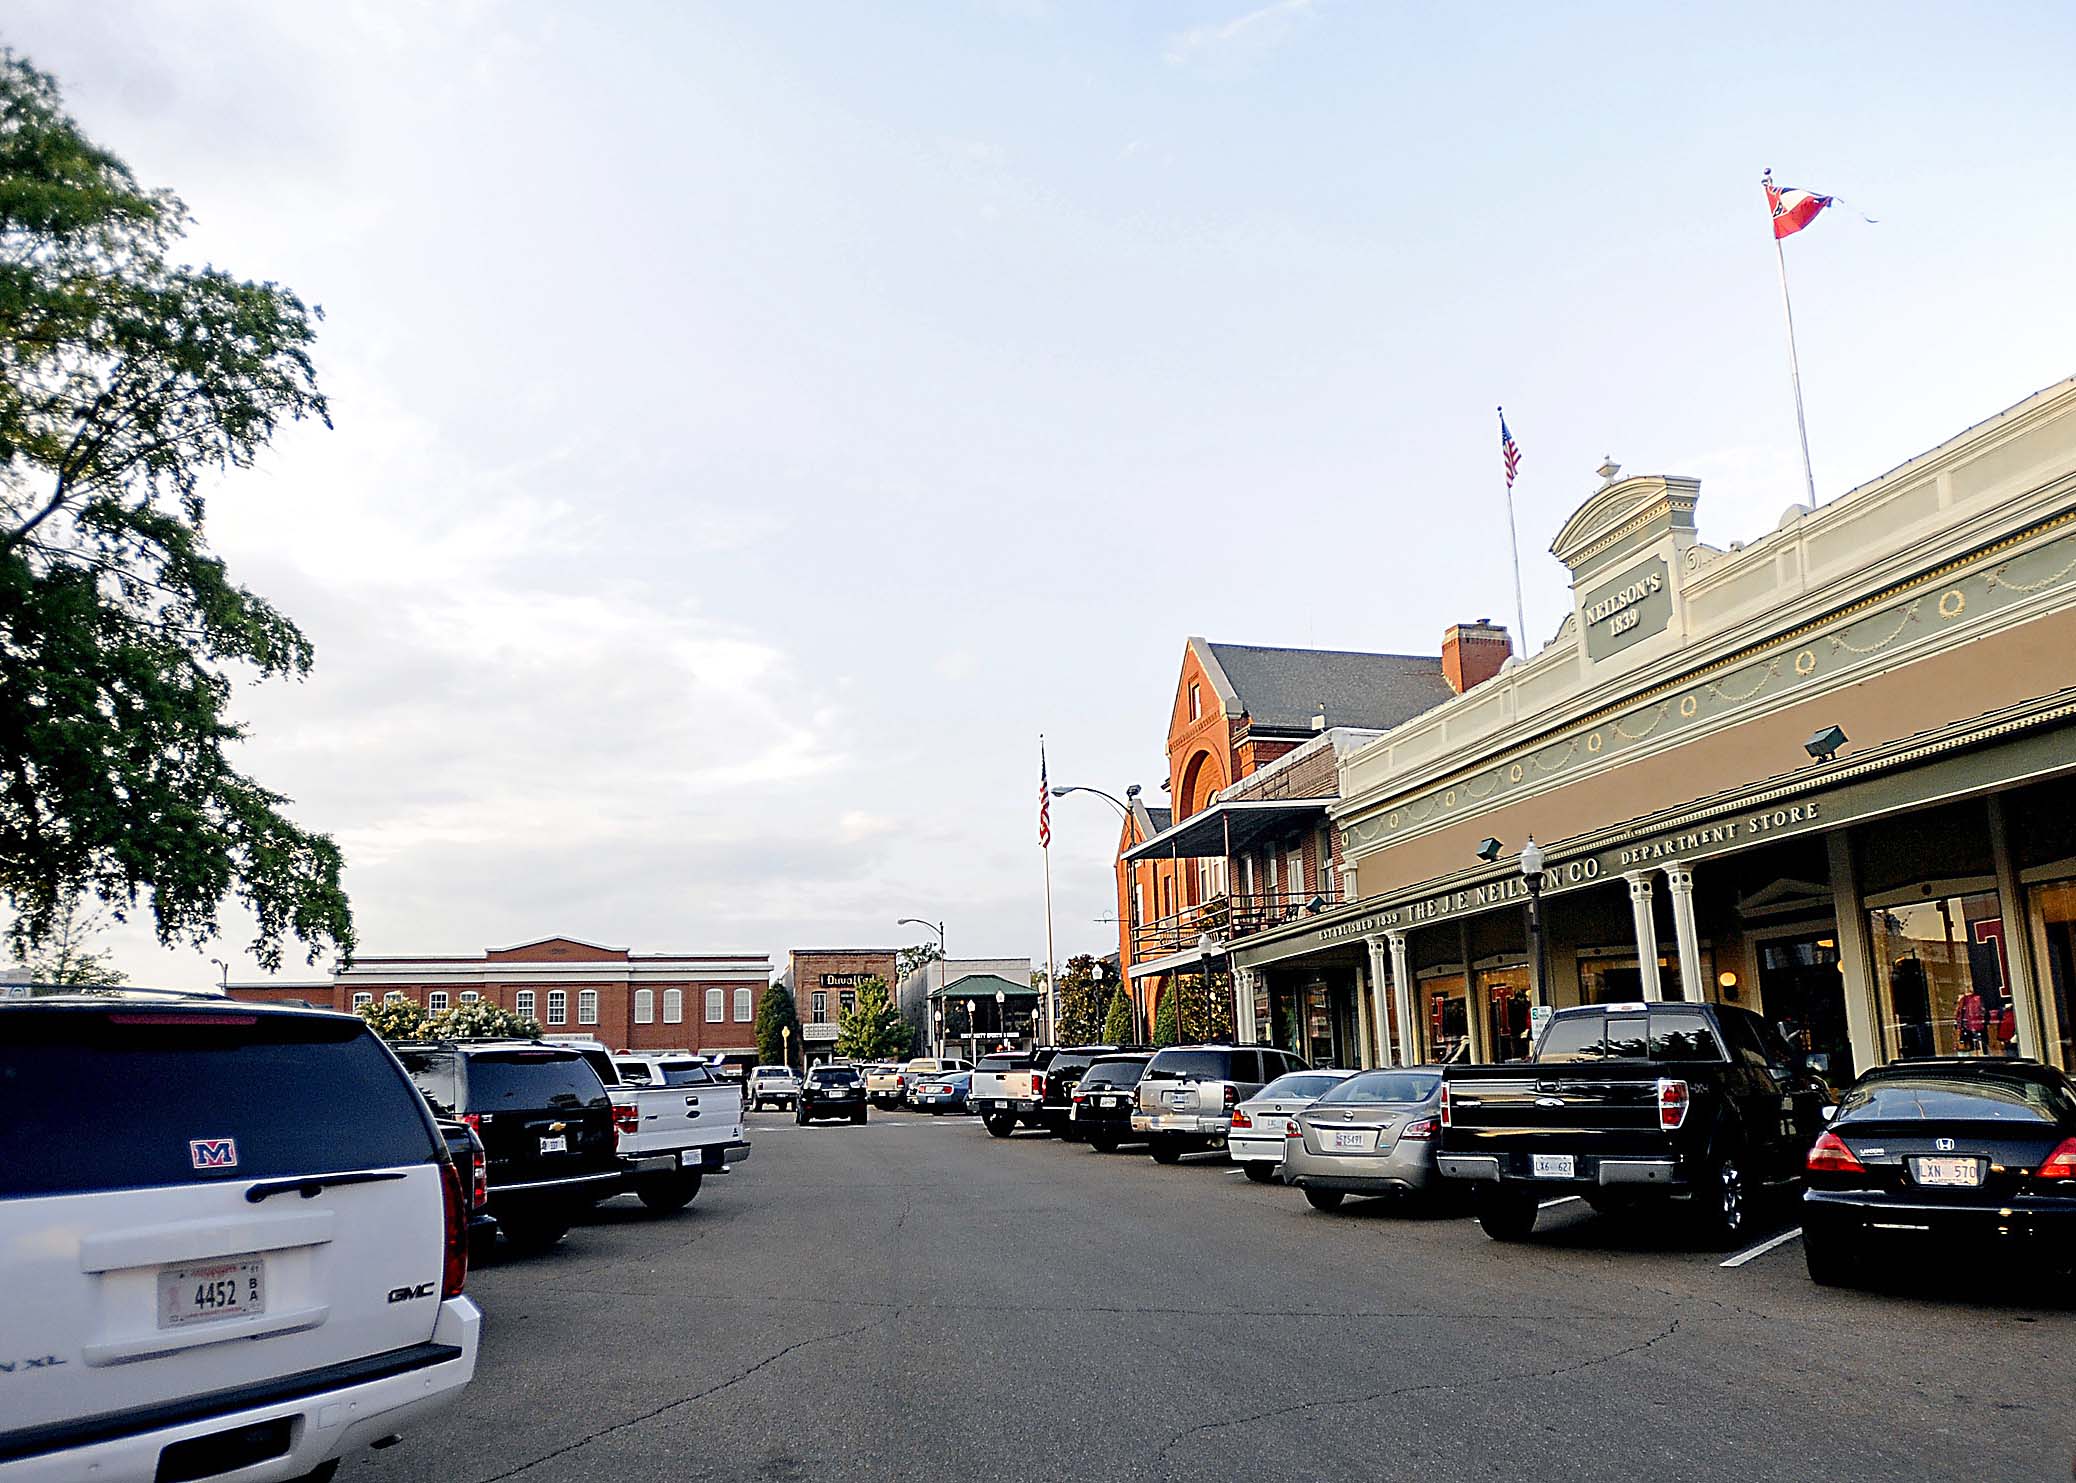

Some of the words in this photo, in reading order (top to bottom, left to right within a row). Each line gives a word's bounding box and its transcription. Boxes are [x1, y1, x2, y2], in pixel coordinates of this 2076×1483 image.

[1585, 572, 1662, 626] NEILSON'S
[1609, 608, 1641, 637] 1839
[1318, 918, 1373, 941] ESTABLISHED
[1376, 913, 1398, 927] 1839
[1407, 900, 1437, 922] THE
[1621, 823, 1737, 865] DEPARTMENT
[1749, 802, 1819, 833] STORE
[1558, 1161, 1572, 1172] 627
[1920, 1165, 1941, 1178] LXN
[1954, 1165, 1976, 1178] 570
[194, 1279, 236, 1309] 4452
[387, 1281, 435, 1304] GMC
